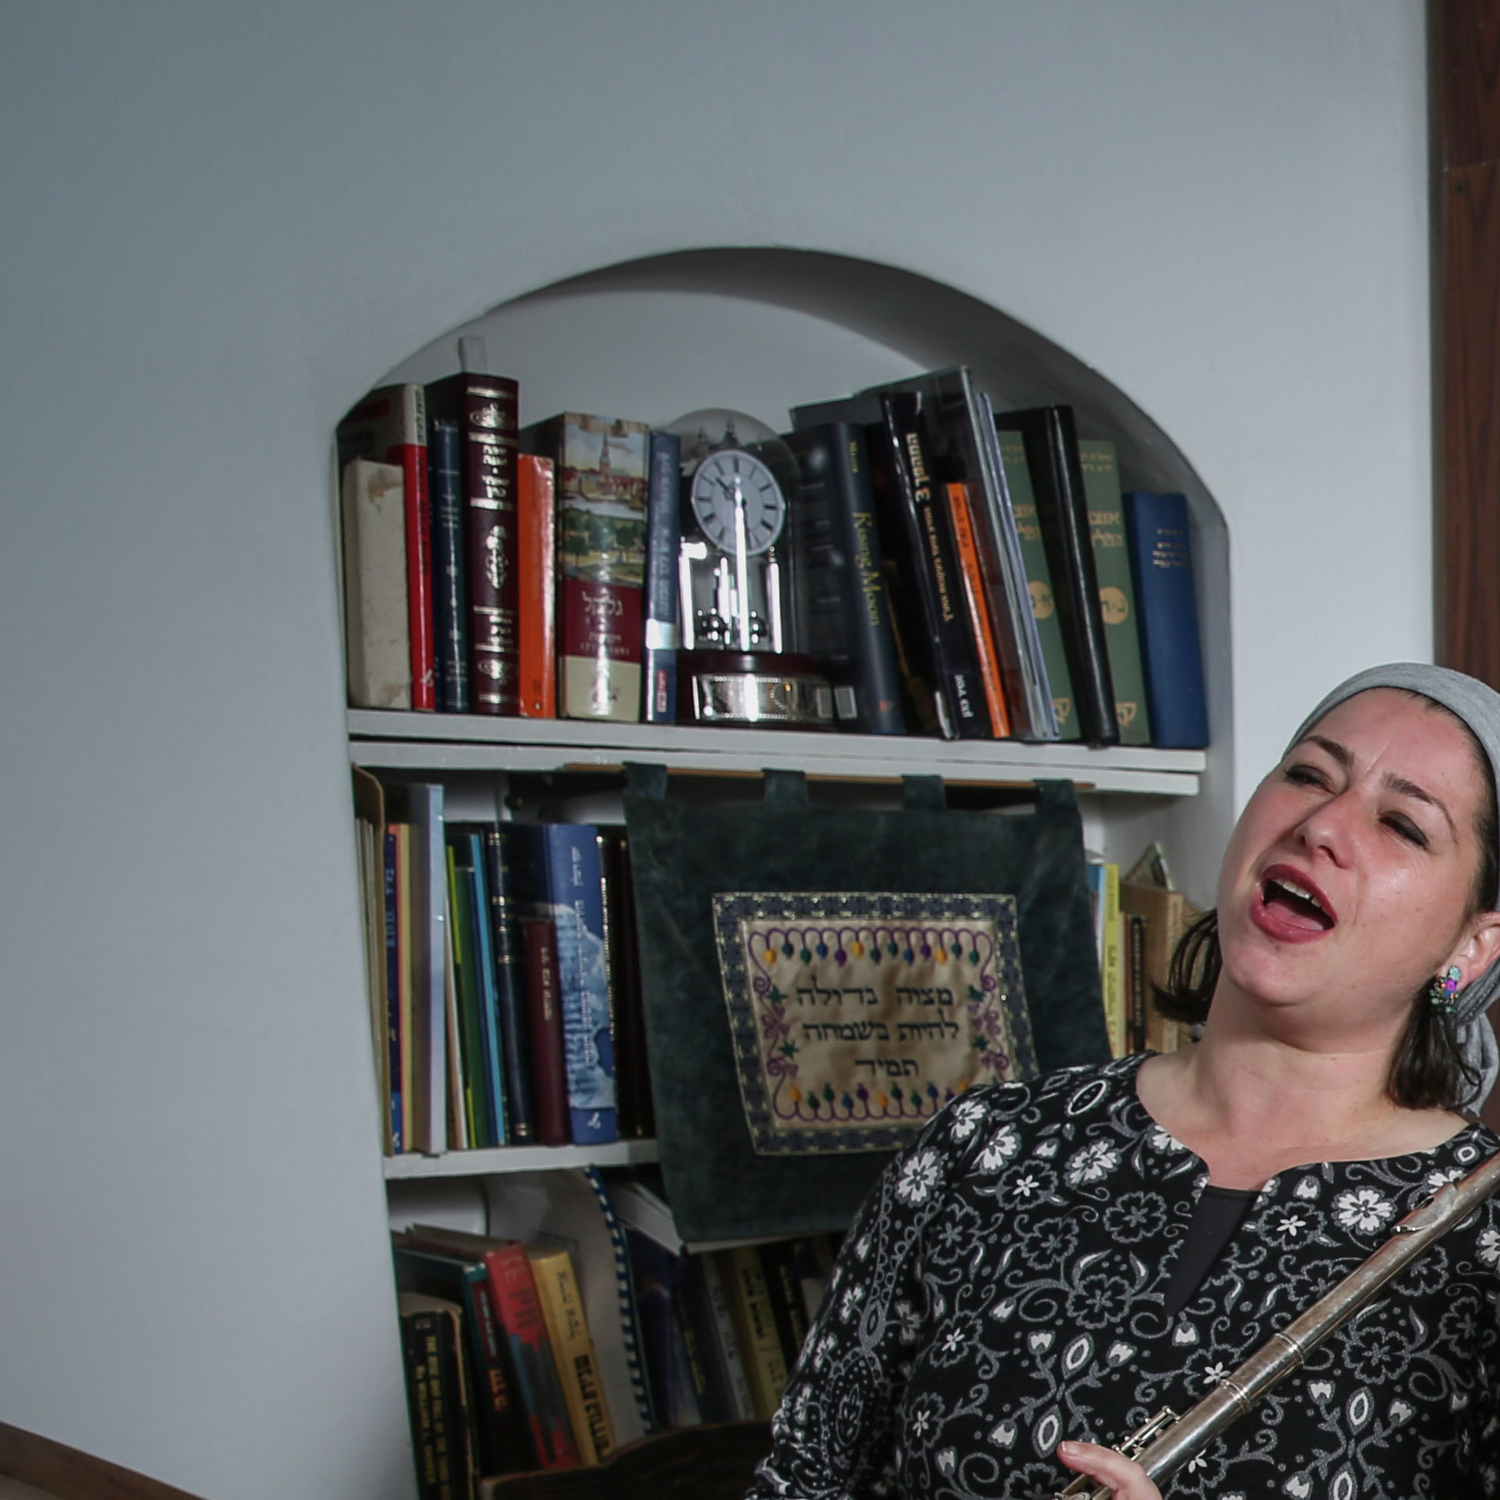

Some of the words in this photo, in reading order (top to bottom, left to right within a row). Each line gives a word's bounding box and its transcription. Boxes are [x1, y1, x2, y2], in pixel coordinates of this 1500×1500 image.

[915, 488, 930, 504] 3
[852, 511, 874, 570] Rising
[862, 571, 884, 627] Moon
[796, 975, 879, 1006] גדולה
[895, 986, 954, 1006] מצוה
[802, 1020, 890, 1042] בשמחה
[897, 1008, 960, 1041] להיות
[854, 1058, 920, 1077] תמיד
